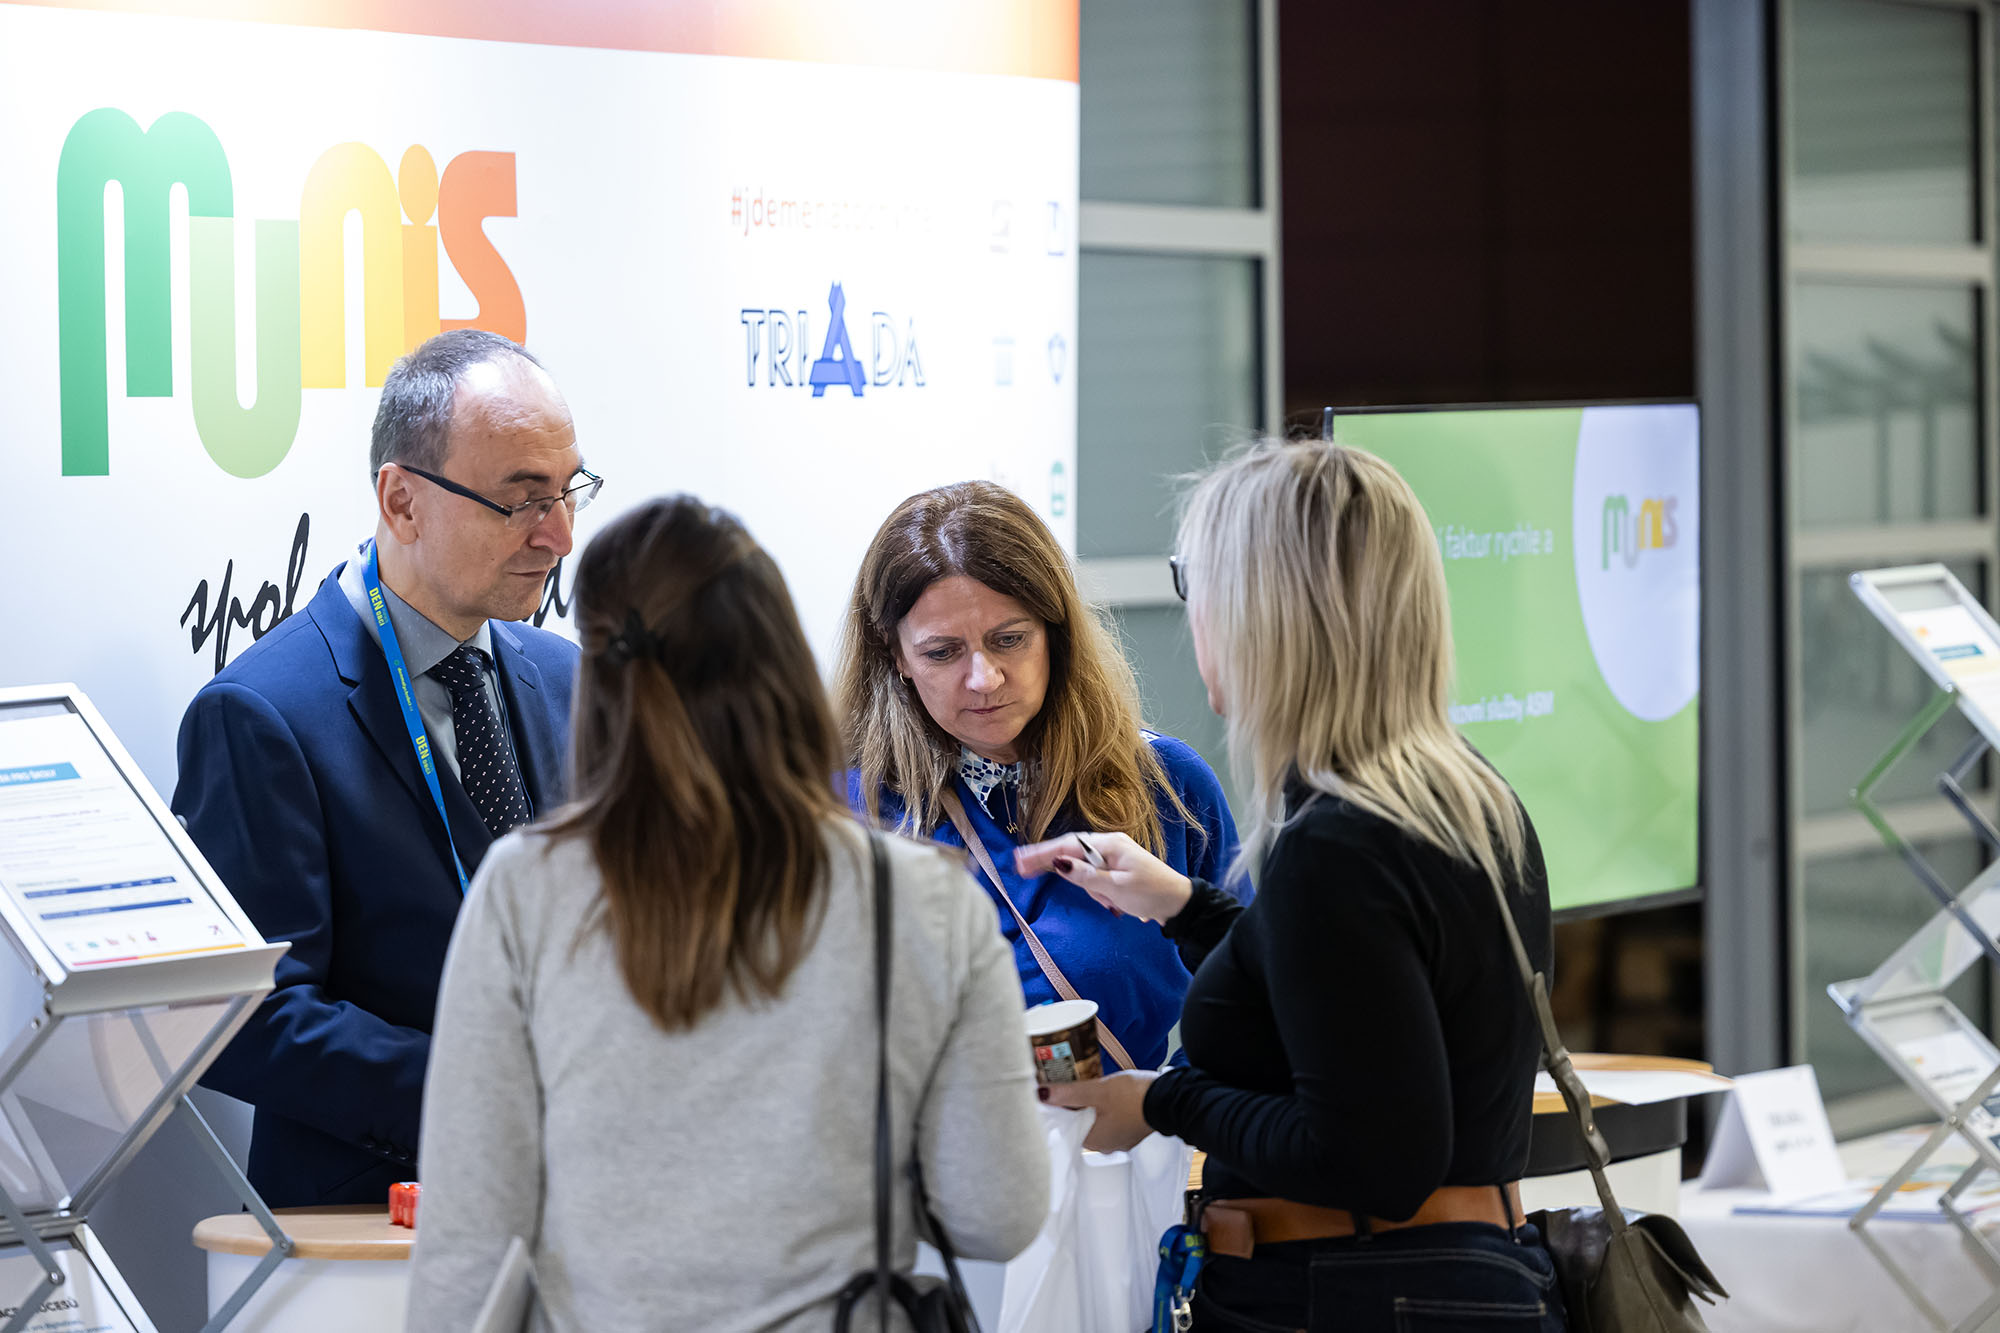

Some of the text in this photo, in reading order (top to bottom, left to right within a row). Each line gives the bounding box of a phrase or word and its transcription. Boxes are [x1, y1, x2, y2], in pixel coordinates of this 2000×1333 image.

[741, 281, 926, 398] TRIADA
[369, 587, 384, 611] DEN
[416, 735, 430, 759] DEN
